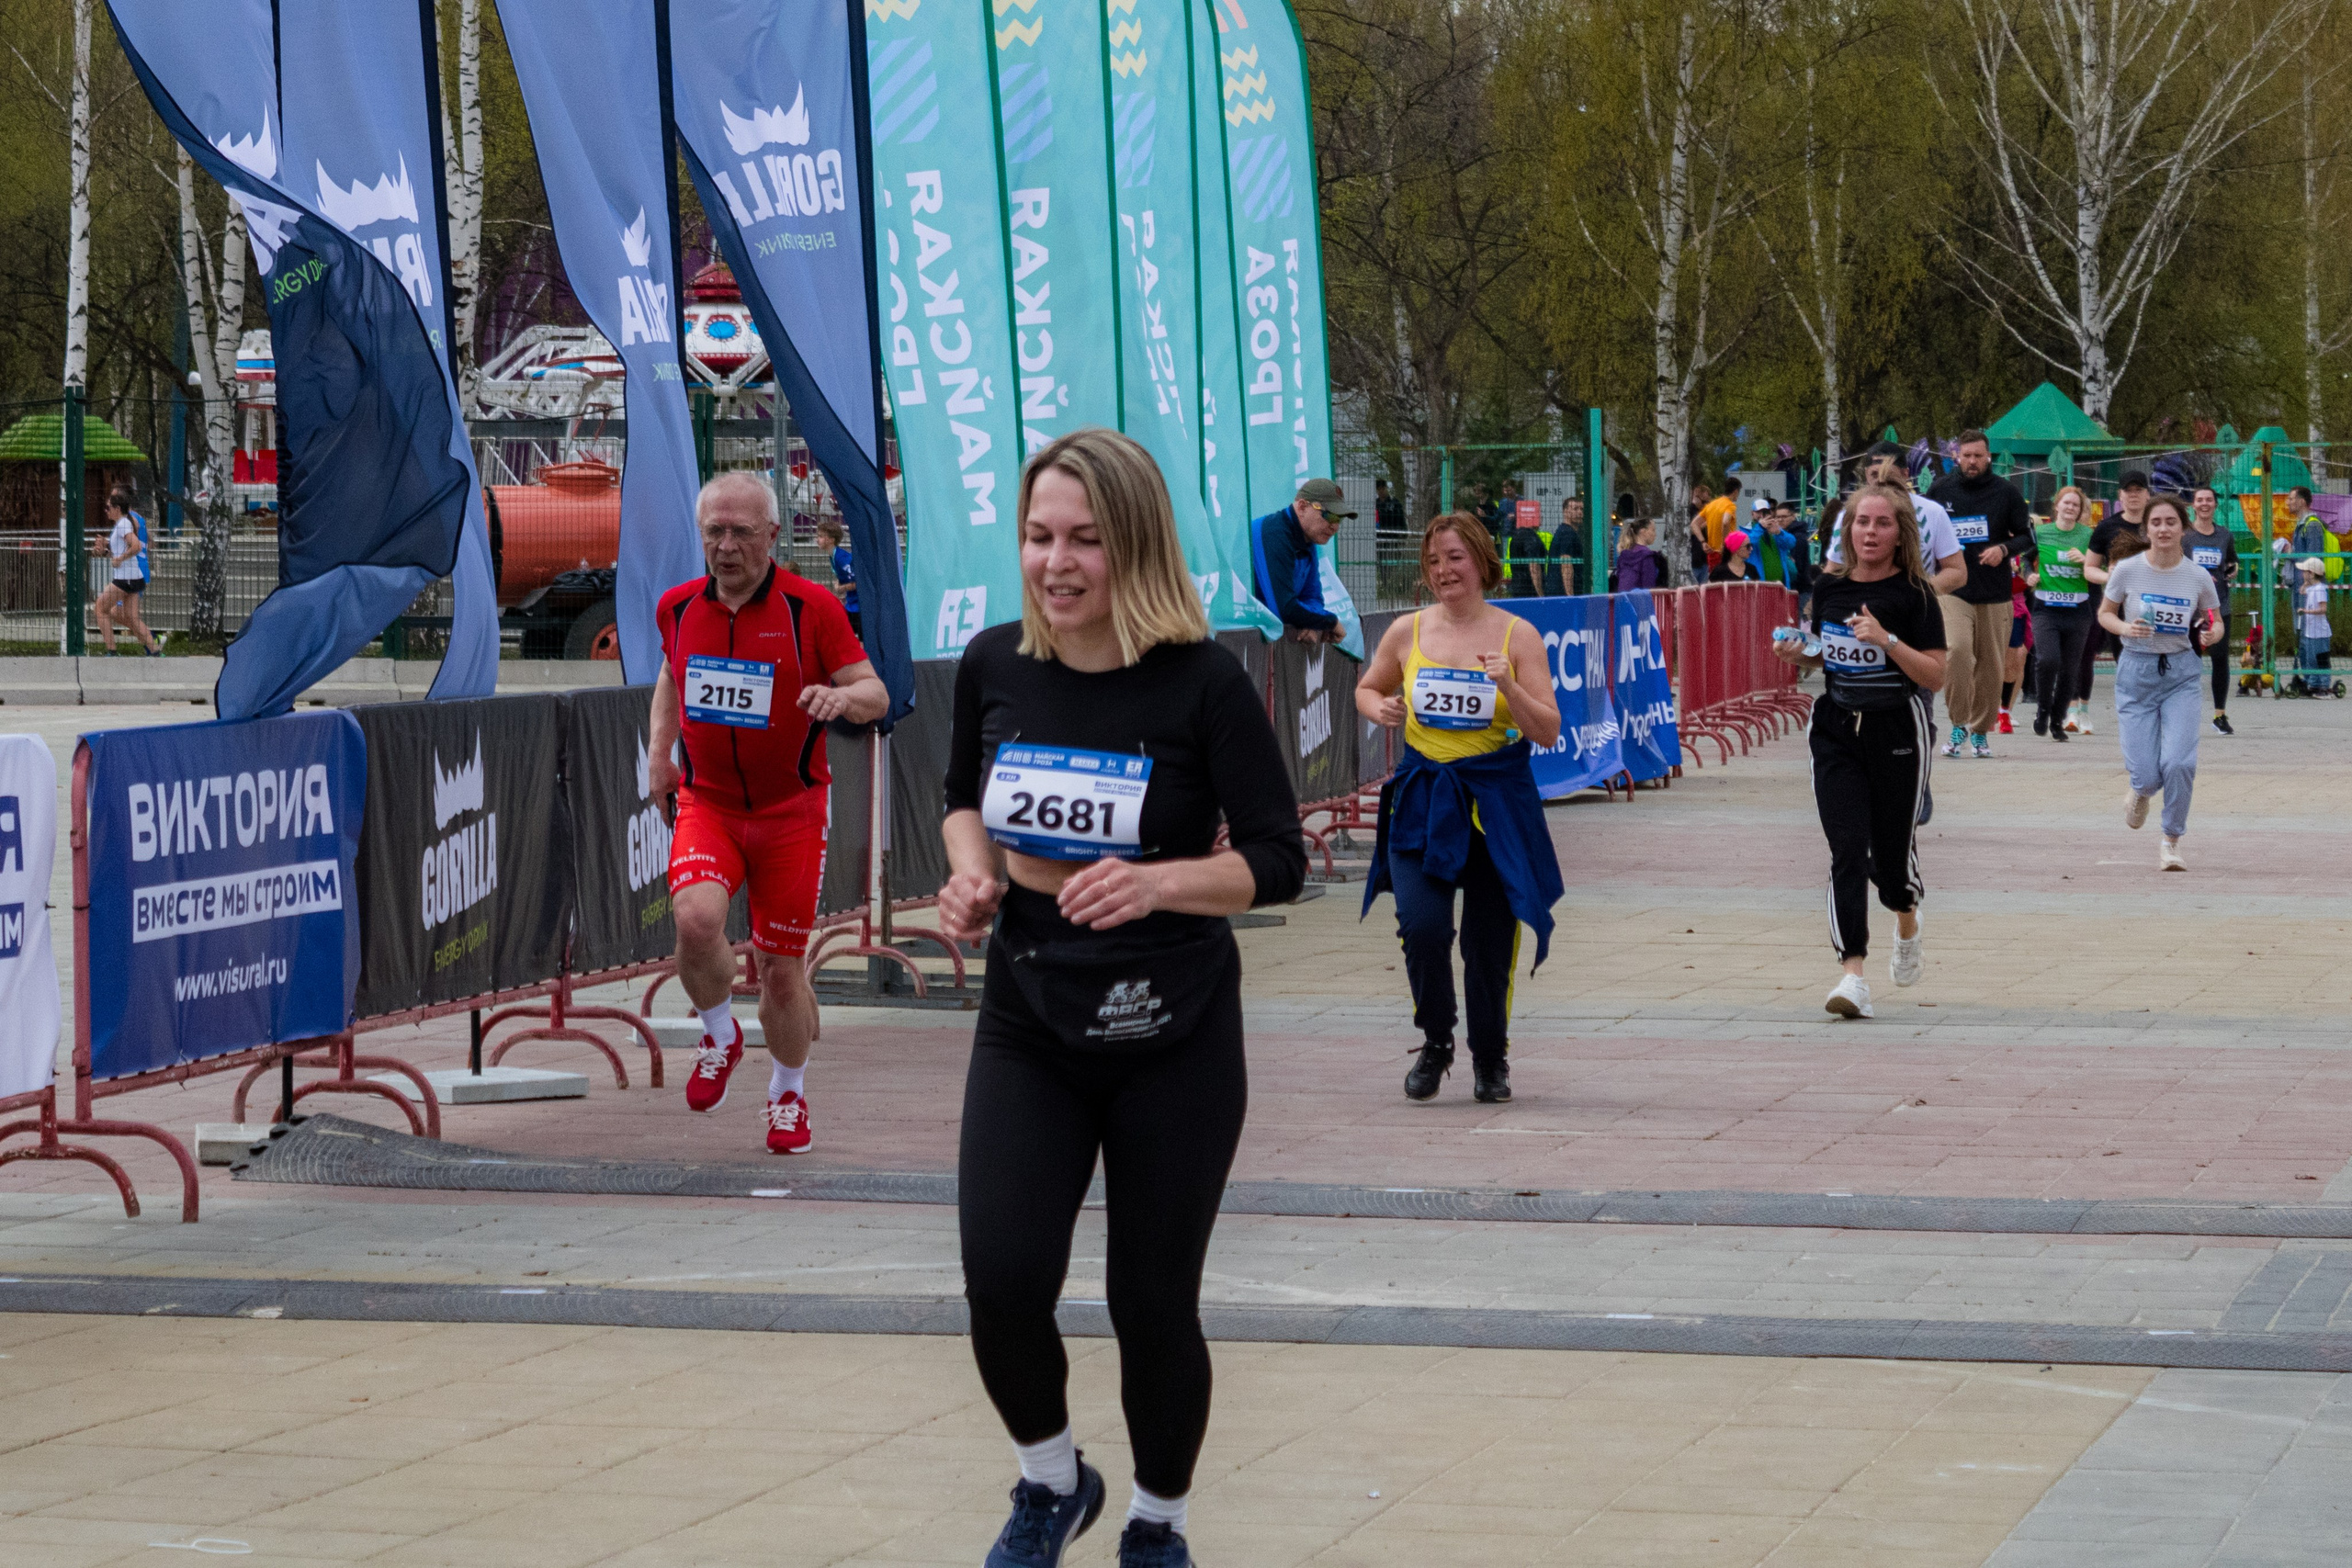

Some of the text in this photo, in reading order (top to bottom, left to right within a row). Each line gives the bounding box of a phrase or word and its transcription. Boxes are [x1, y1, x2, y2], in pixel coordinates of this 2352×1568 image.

[1955, 526, 1984, 537] 2296
[2198, 555, 2218, 564] 2312
[2049, 592, 2075, 602] 2059
[1826, 644, 1878, 664] 2640
[699, 683, 753, 710] 2115
[1423, 692, 1482, 716] 2319
[1094, 781, 1143, 793] ВИКТОРИЯ
[128, 763, 334, 863] ВИКТОРИЯ
[1006, 791, 1117, 838] 2681
[421, 812, 498, 931] GORILLA
[174, 952, 288, 1002] www.visural.ru
